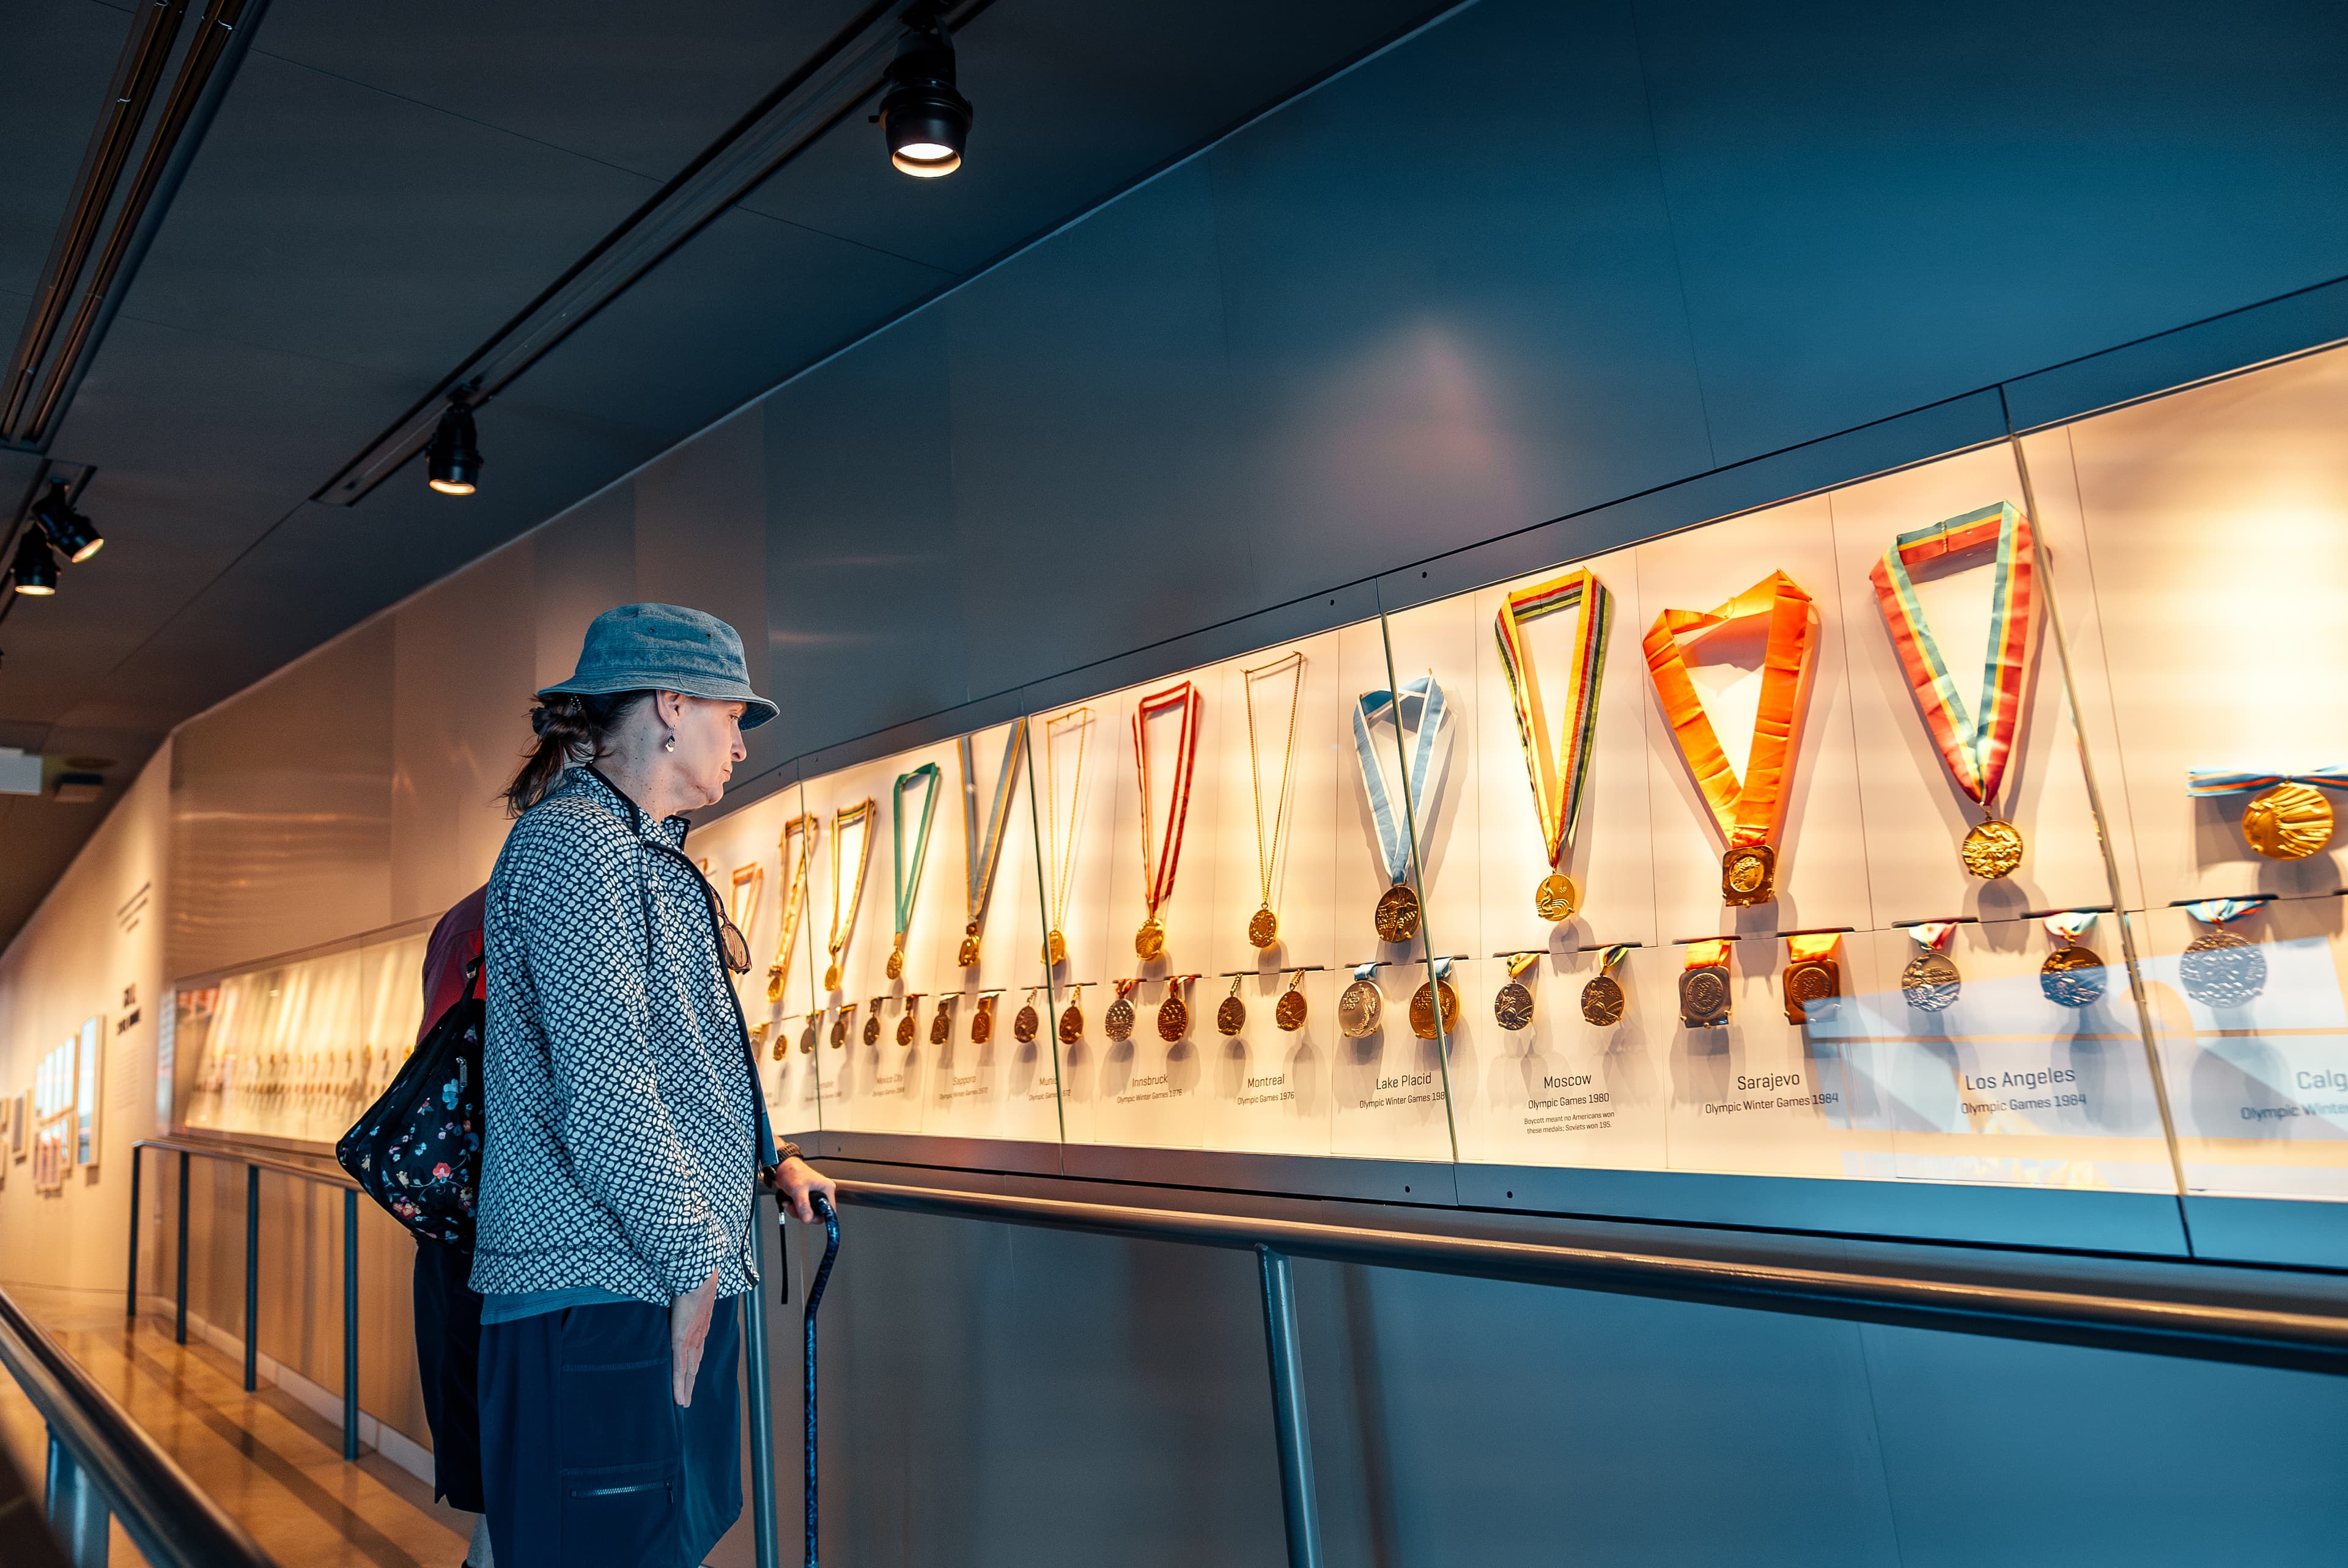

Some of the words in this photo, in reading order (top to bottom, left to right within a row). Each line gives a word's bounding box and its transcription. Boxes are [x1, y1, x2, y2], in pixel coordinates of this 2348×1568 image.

[1039, 1076, 1057, 1086] Munic
[1132, 1073, 1168, 1088] Innsbruck
[1247, 1073, 1285, 1088] Montreal
[1376, 1077, 1398, 1090] Lake
[1401, 1072, 1431, 1087] Placid
[1544, 1075, 1592, 1089] Moscow
[1737, 1073, 1800, 1091] Sarajevo
[1965, 1075, 1997, 1091] Los
[2002, 1067, 2076, 1089] Angeles
[2297, 1069, 2348, 1092] Calg
[1117, 1096, 1135, 1105] Olympic
[1169, 1089, 1183, 1097] 1976
[1237, 1096, 1259, 1105] Olympic
[1280, 1091, 1294, 1100] 1976
[1359, 1099, 1384, 1110] Olympic
[1386, 1097, 1406, 1106] Winter
[1408, 1094, 1431, 1103] Games
[1431, 1091, 1445, 1101] 198
[1528, 1098, 1559, 1111] Olympic
[1560, 1096, 1587, 1106] Games
[1589, 1092, 1609, 1103] 1980
[1705, 1102, 1742, 1116] Olympic
[1743, 1100, 1774, 1111] Winter
[1776, 1097, 1811, 1108] Games
[1812, 1093, 1839, 1105] 1984
[1961, 1100, 2007, 1116] Olympic
[2009, 1099, 2051, 1111] Games
[2053, 1094, 2087, 1108] 1984
[2240, 1104, 2300, 1122] Olympic
[2302, 1103, 2348, 1116] Winte
